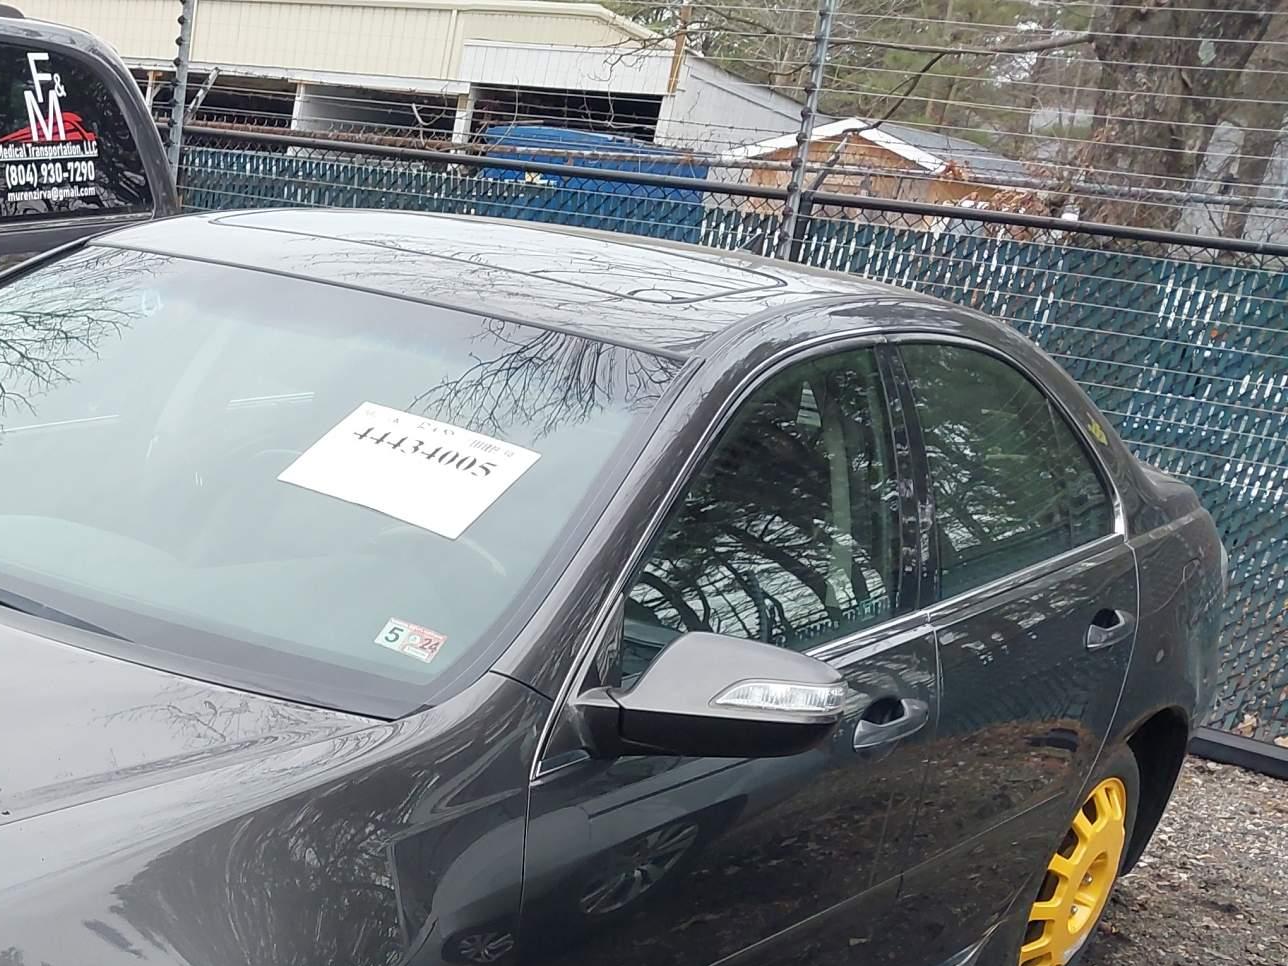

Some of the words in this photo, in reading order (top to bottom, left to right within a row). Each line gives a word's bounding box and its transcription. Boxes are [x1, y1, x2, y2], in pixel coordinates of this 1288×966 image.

[27, 52, 50, 103] F
[53, 73, 67, 97] &
[24, 90, 66, 141] M
[83, 140, 98, 155] LLC
[5, 163, 38, 189] (804)
[40, 160, 95, 184] 930-7290
[7, 185, 96, 201] murenzirva@gmail.com
[352, 425, 499, 479] 44434005
[384, 626, 404, 643] 5
[419, 638, 440, 654] 24
